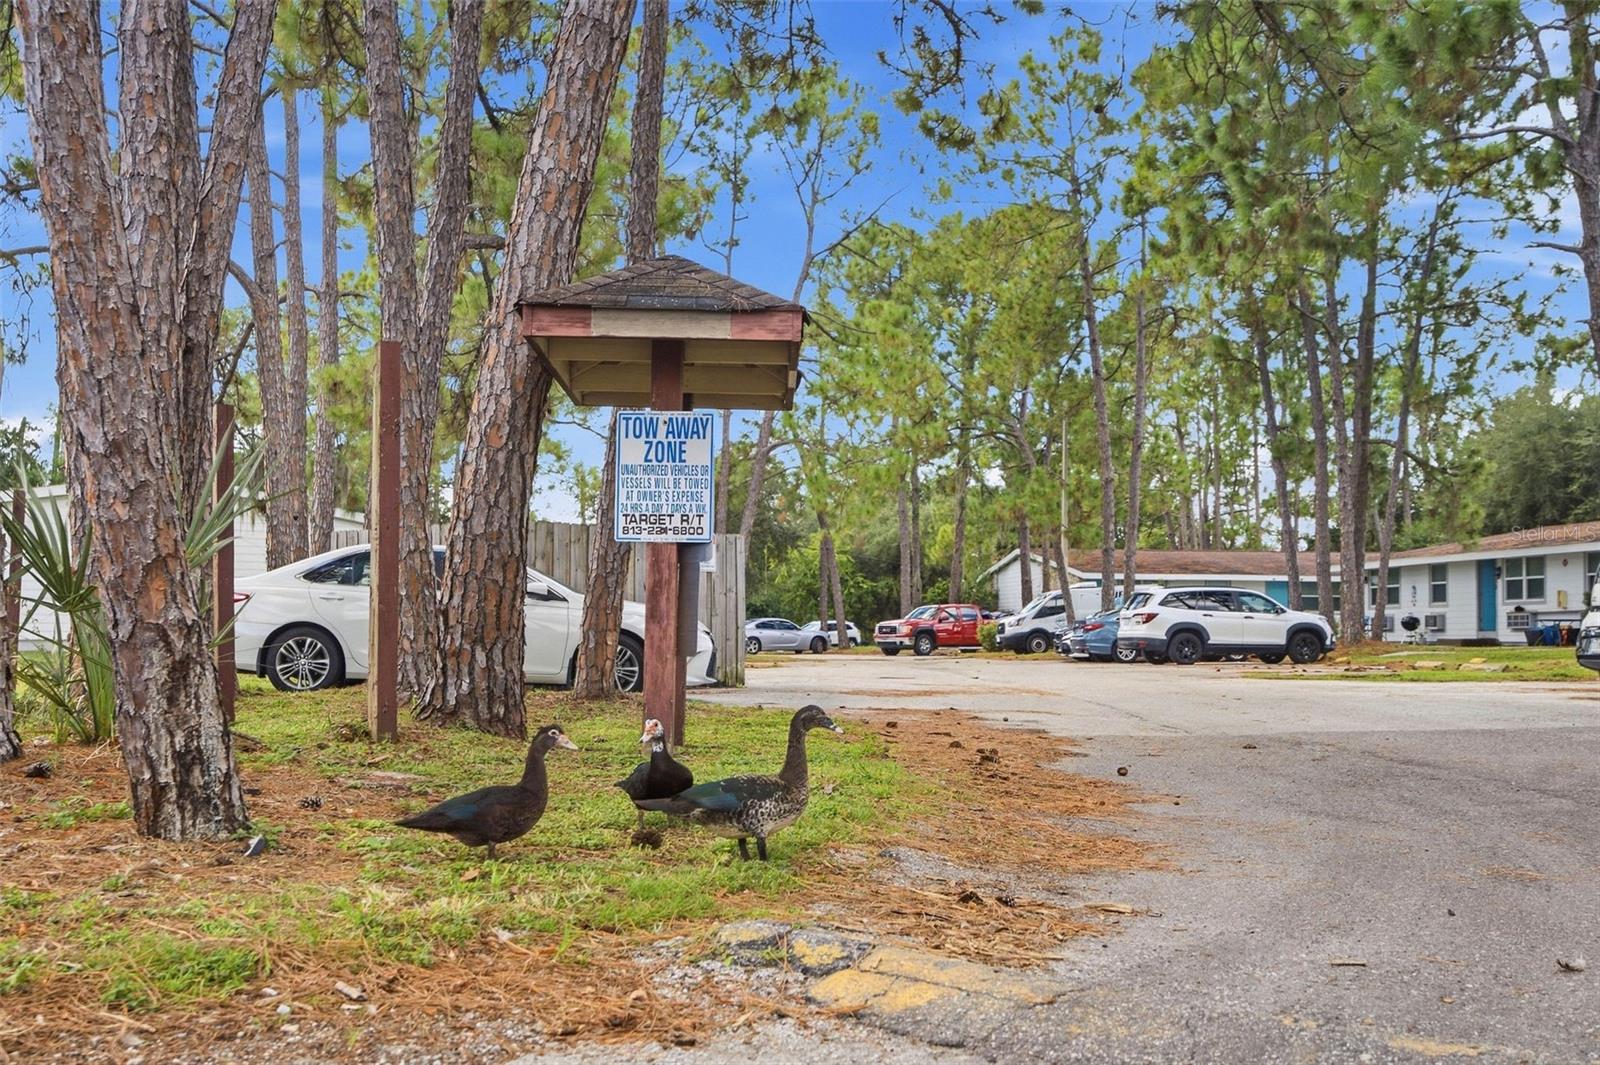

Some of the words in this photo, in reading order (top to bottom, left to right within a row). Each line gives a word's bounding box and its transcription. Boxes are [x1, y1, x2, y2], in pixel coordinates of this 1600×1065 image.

[622, 416, 660, 440] TOW
[665, 416, 710, 440] AWAY
[643, 440, 687, 463] ZONE
[621, 464, 669, 476] UNAUTHORIZED
[670, 464, 699, 477] VEHICLES
[700, 465, 709, 477] OR
[621, 477, 652, 489] VESSELS
[654, 477, 671, 489] WILL
[673, 477, 682, 489] BE
[684, 477, 709, 489] TOWED
[625, 490, 634, 502] AT
[637, 490, 670, 502] OWNER'S
[672, 491, 704, 502] EXPENSE
[620, 503, 629, 513] 24
[630, 503, 643, 513] HRS
[645, 503, 650, 513] A
[651, 503, 664, 513] DAY
[665, 503, 670, 513] 7
[670, 504, 687, 513] DAYS
[688, 504, 694, 513] A
[622, 514, 675, 525] TARGET
[680, 514, 704, 526] R/T
